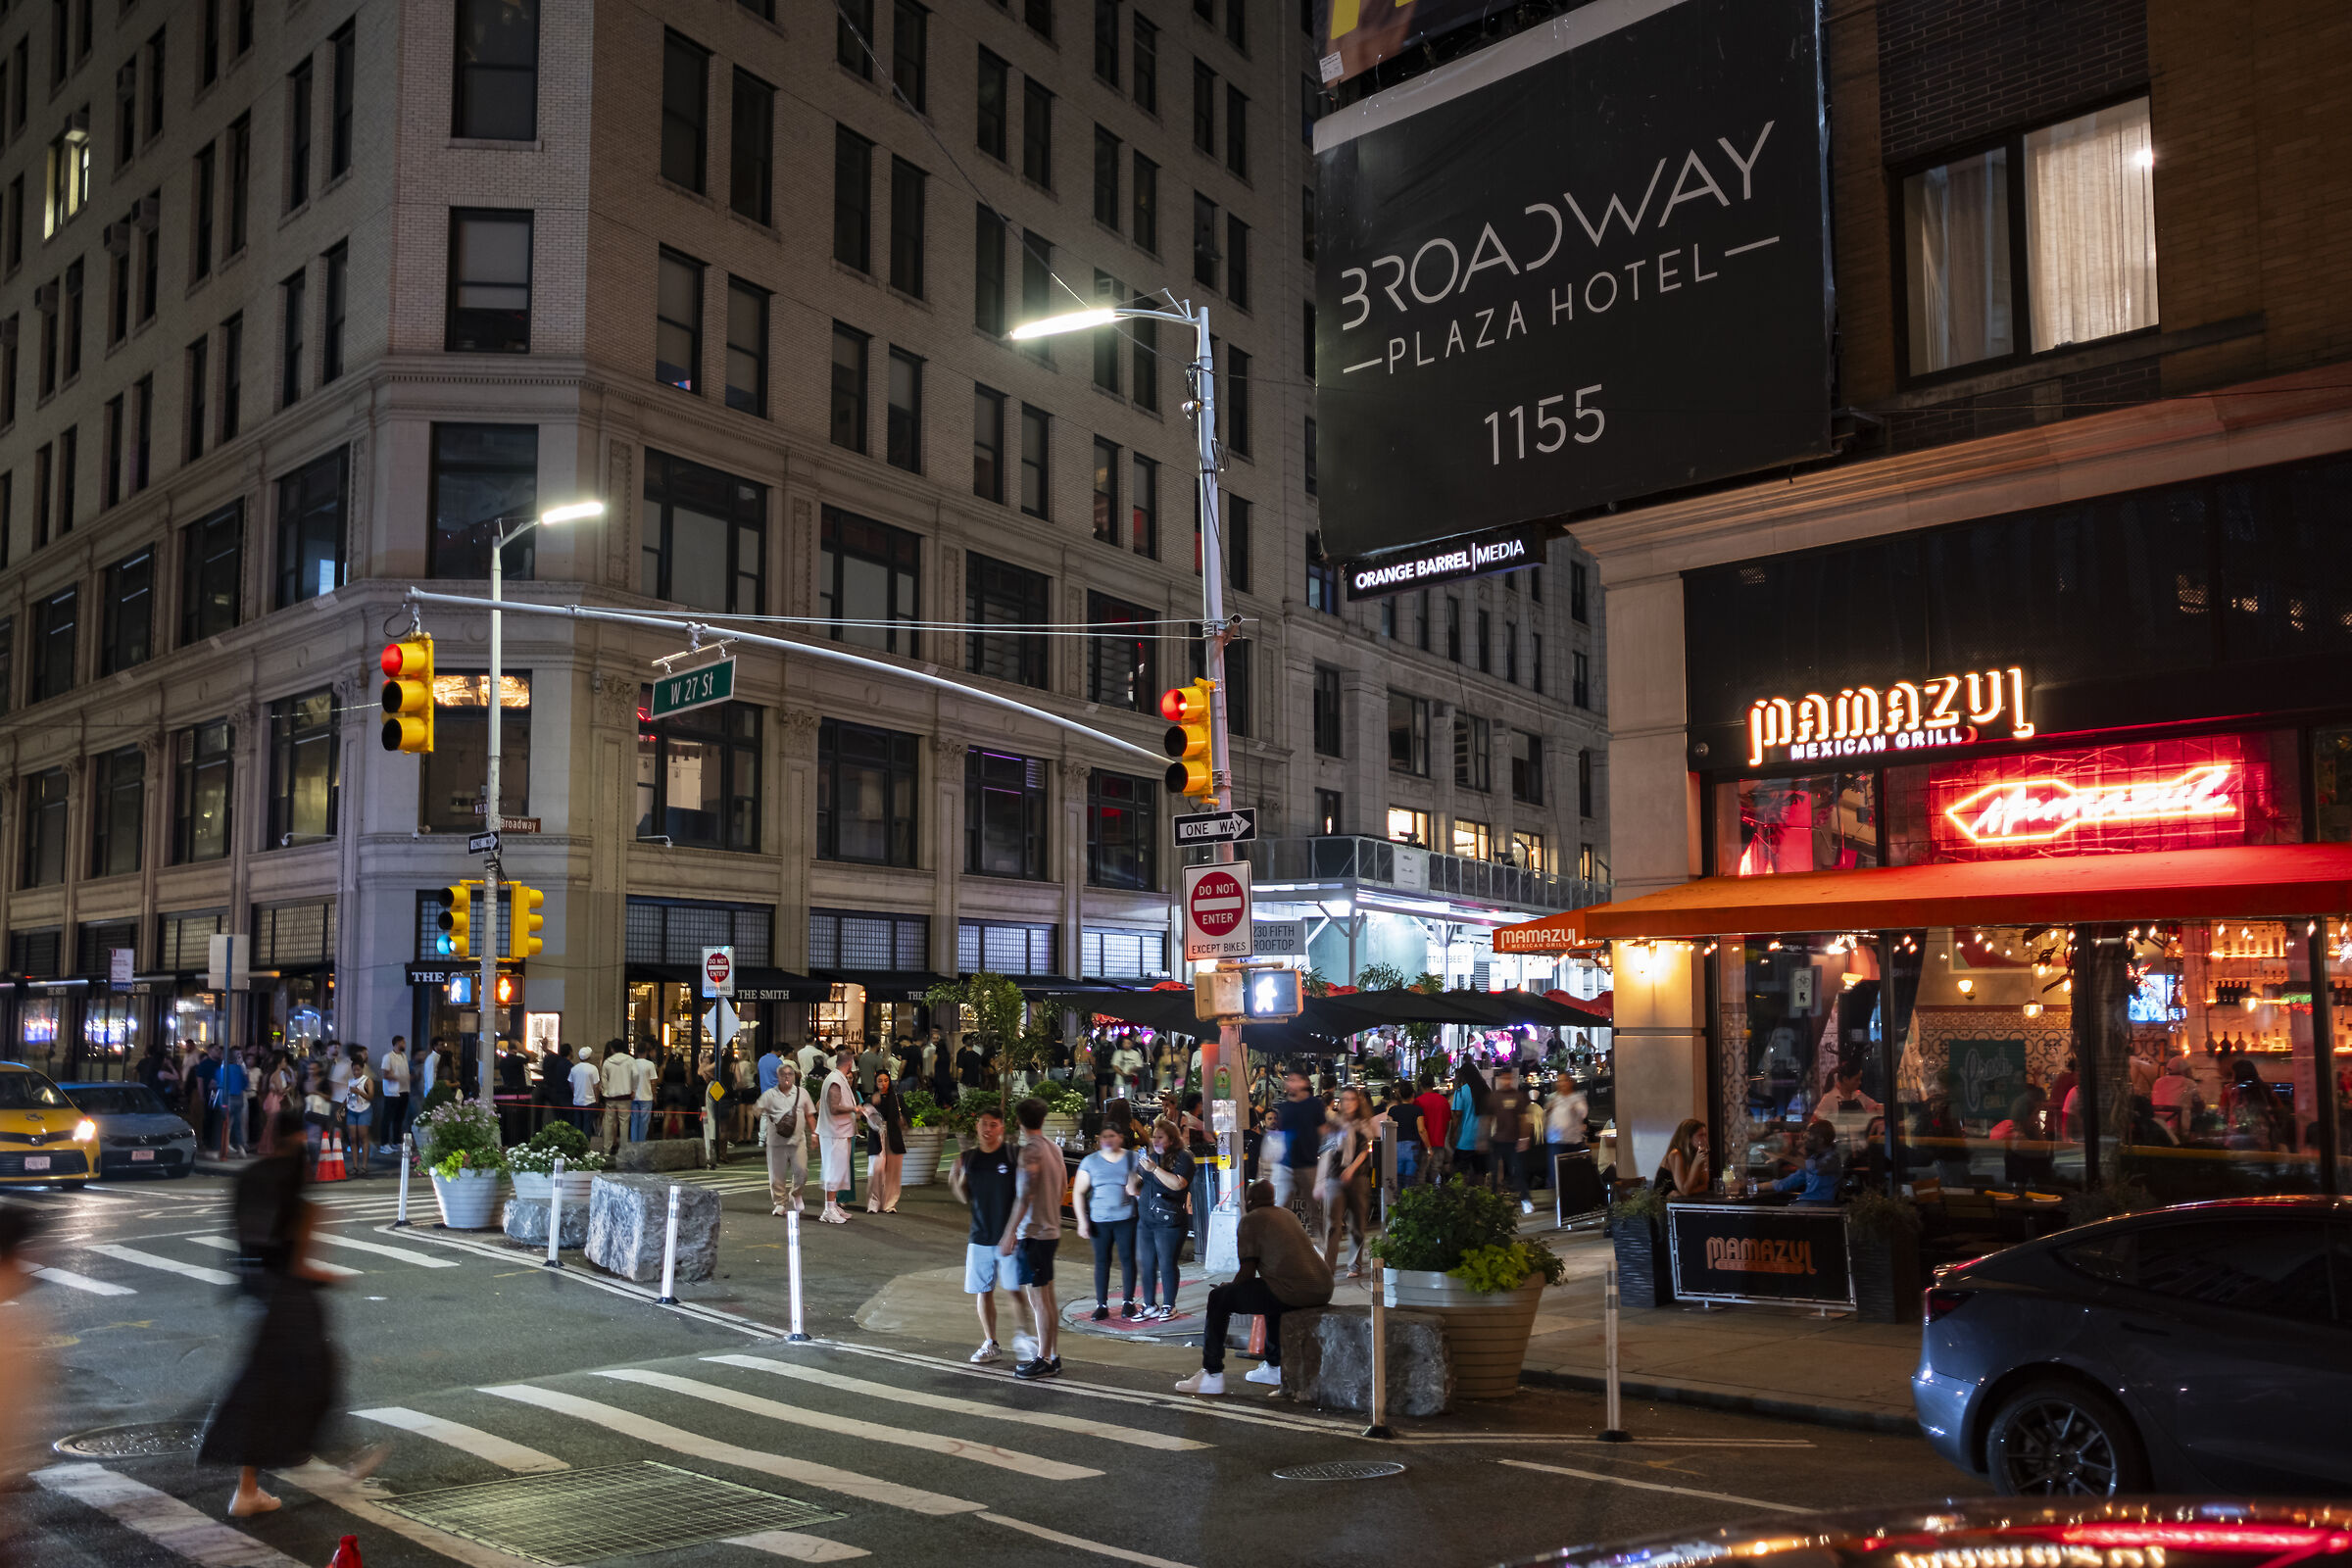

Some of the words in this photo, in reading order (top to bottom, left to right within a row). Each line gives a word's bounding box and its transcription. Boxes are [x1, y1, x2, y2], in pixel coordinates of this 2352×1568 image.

[1342, 121, 1775, 330] BROADWAY
[1389, 300, 1527, 374] PLAZA
[1551, 242, 1718, 325] HOTEL
[1485, 384, 1606, 466] 1155
[1355, 563, 1414, 590] ORANGE
[1417, 551, 1470, 577] BARREL
[1476, 539, 1525, 564] MEDIA
[670, 682, 681, 706] W
[685, 676, 698, 702] 27
[702, 671, 713, 697] St
[1790, 735, 1887, 760] MEXICAN
[1894, 727, 1963, 752] GRILL
[501, 818, 537, 832] Broadway
[1186, 822, 1209, 836] ONE
[1219, 819, 1244, 833] WAY
[1199, 885, 1212, 896] DO
[1216, 883, 1236, 895] NOT
[1201, 912, 1234, 925] ENTER
[1269, 925, 1295, 937] FIFTH
[1501, 928, 1580, 949] MAMAZUL
[1192, 943, 1221, 955] EXCEPT
[1223, 941, 1247, 952] BIKES
[1253, 939, 1295, 952] ROOFTOP
[412, 971, 444, 982] THE
[738, 989, 758, 1000] THE
[760, 990, 790, 1000] SMITH
[907, 991, 923, 1001] THE
[1706, 1237, 1817, 1274] MAMAZUL
